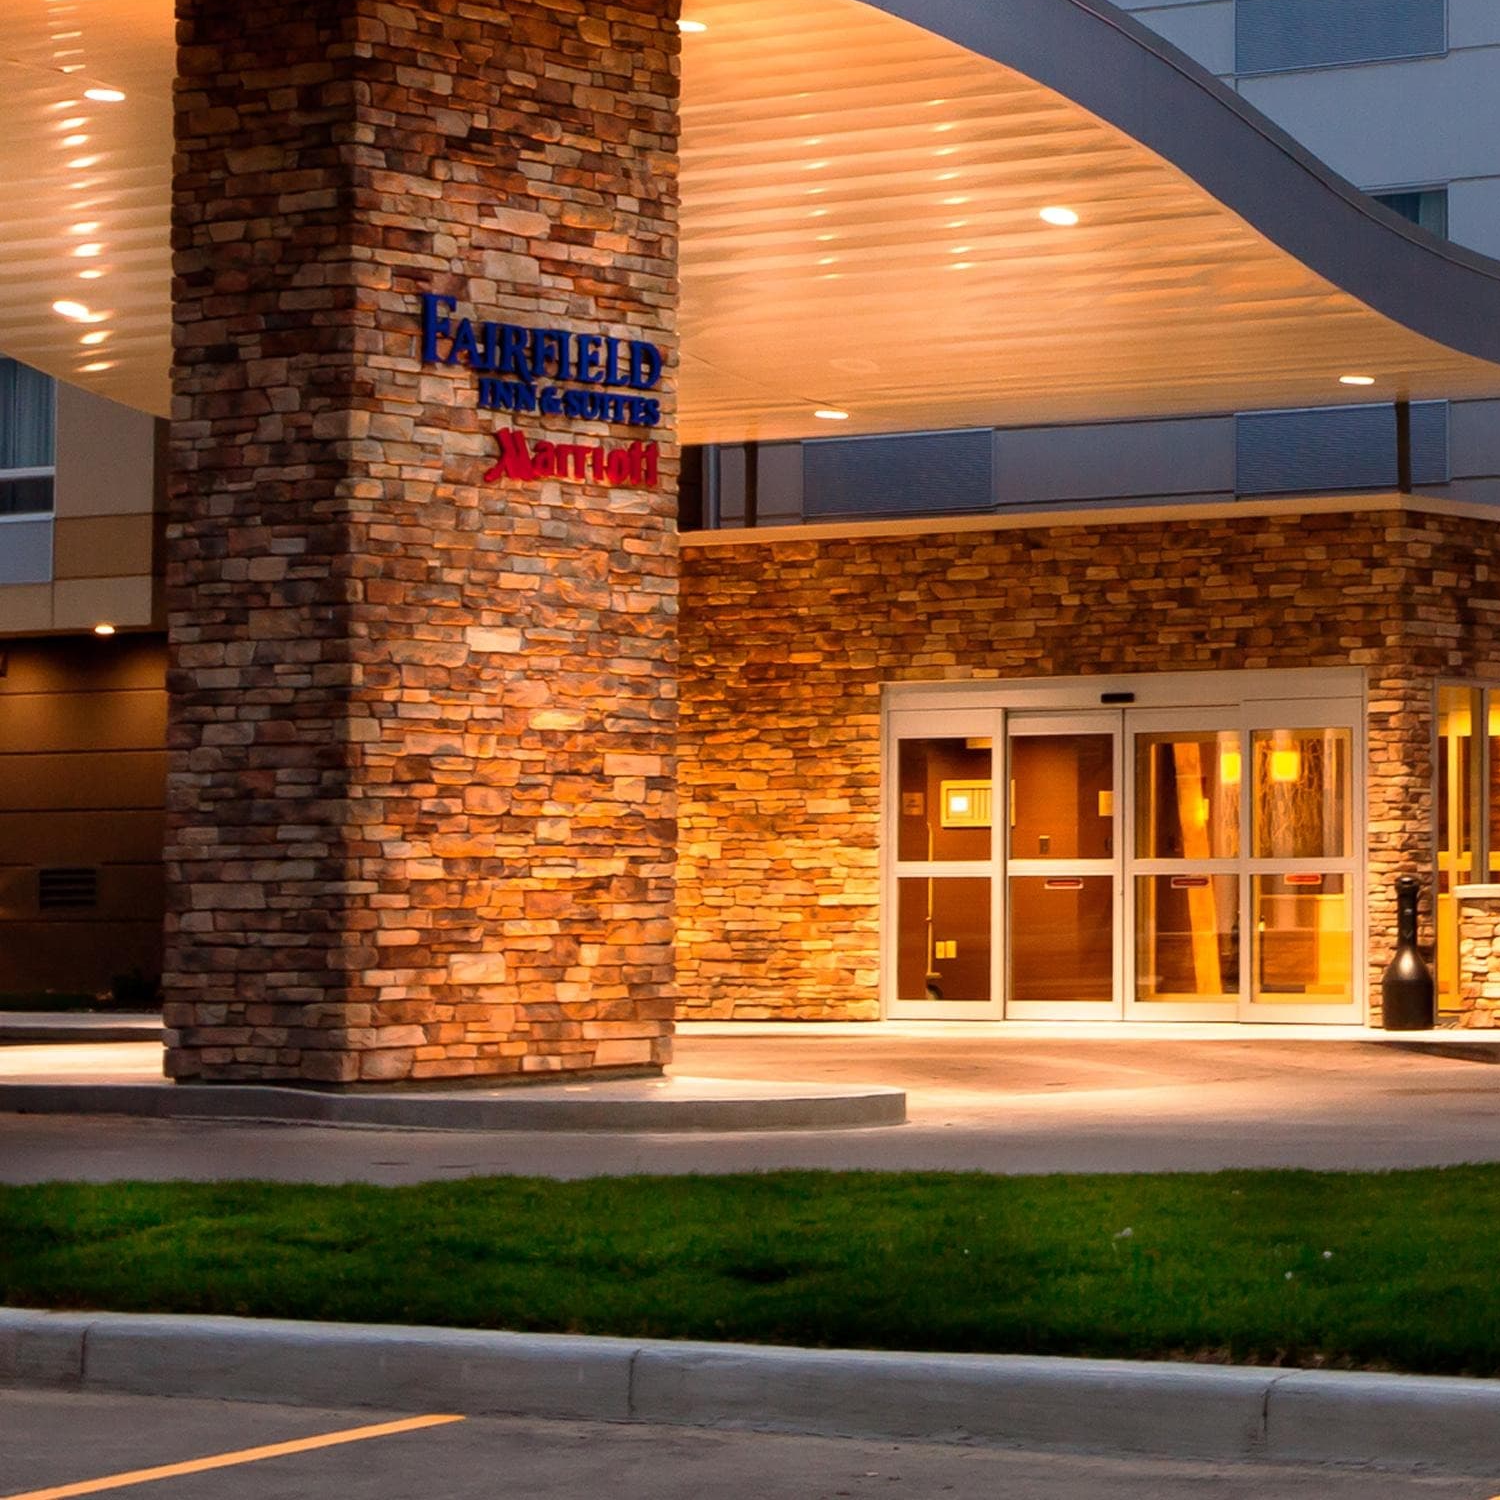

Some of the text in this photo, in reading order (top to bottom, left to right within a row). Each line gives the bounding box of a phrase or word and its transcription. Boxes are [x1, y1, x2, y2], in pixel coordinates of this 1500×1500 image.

[421, 293, 662, 388] FAIRFIELD
[478, 378, 660, 426] INN & SUITES
[483, 427, 658, 486] Marriott
